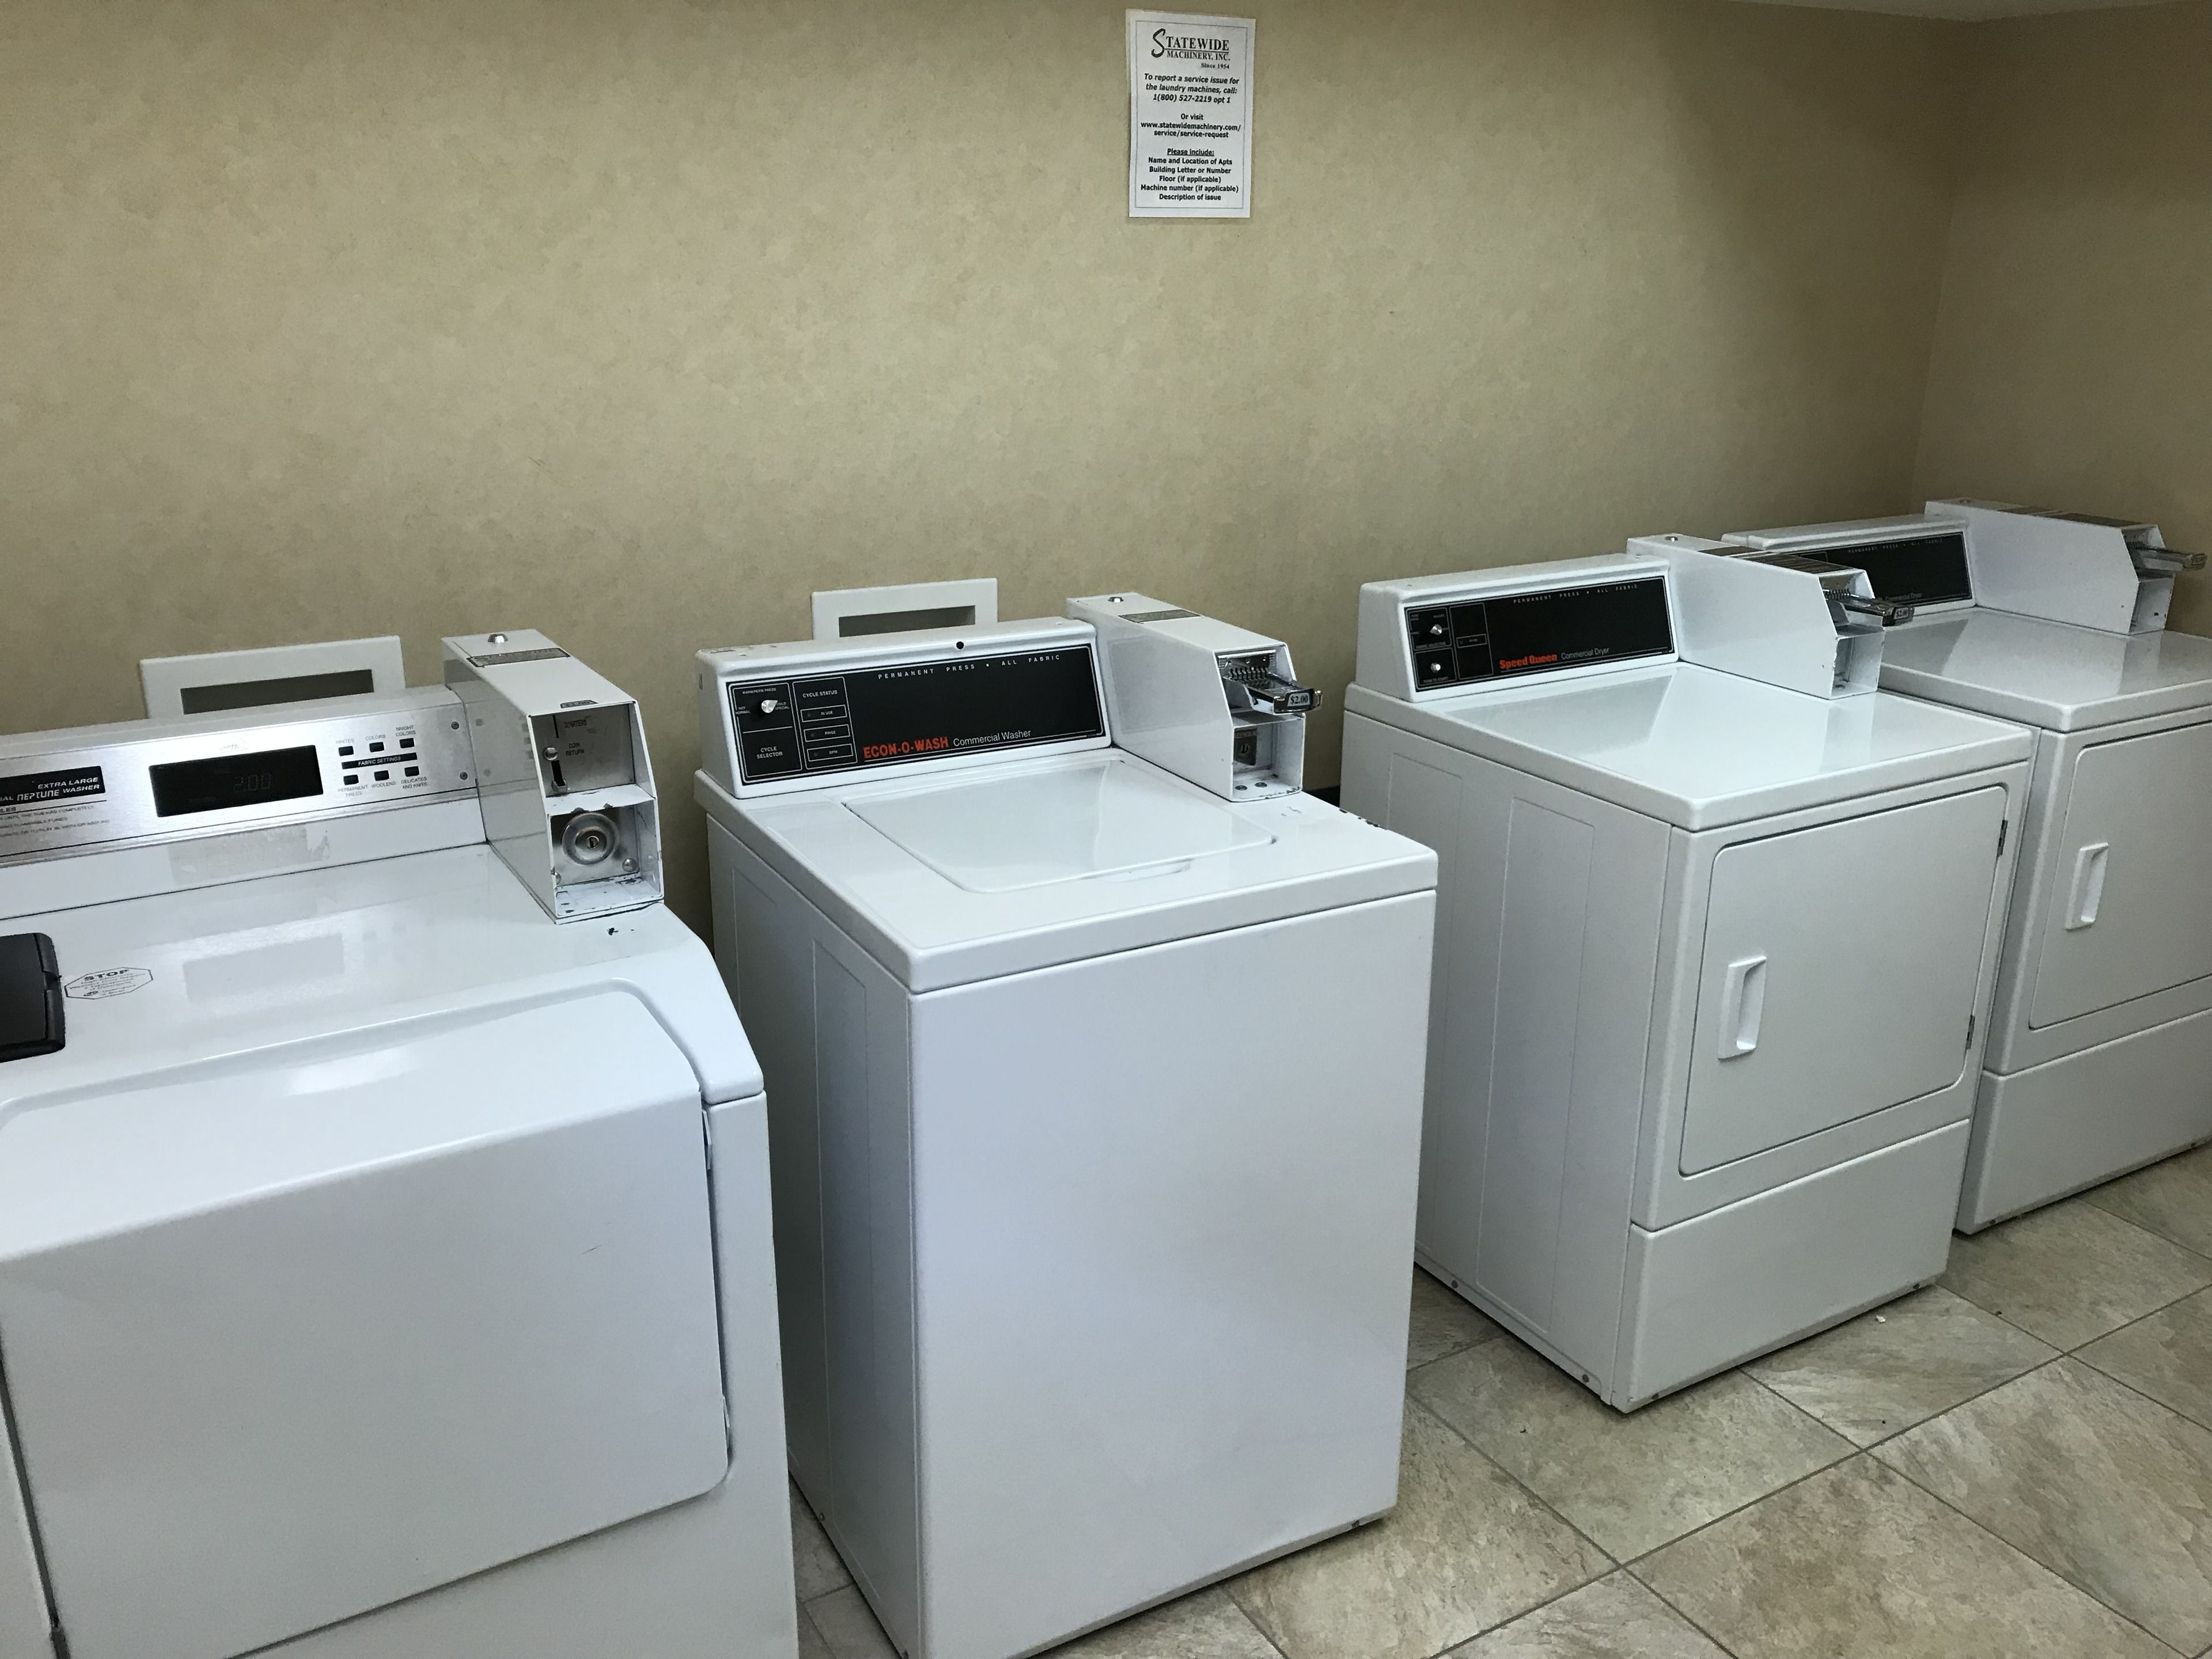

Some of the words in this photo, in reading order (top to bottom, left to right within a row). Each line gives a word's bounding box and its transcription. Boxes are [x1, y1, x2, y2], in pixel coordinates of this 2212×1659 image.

[1152, 28, 1230, 58] STATEWIDE
[1166, 50, 1213, 60] MACHINERY,
[1215, 52, 1230, 61] INC.
[1154, 74, 1176, 83] report
[1228, 77, 1240, 85] for
[1159, 84, 1185, 93] laundry
[1187, 85, 1222, 94] machines,
[1153, 94, 1177, 102] 1(800)
[1179, 94, 1212, 103] 527-2219
[1141, 122, 1241, 132] www.statewidemachinery.com/
[1154, 130, 1229, 139] service/service-request
[1149, 166, 1175, 174] Building
[1187, 176, 1221, 184] applicable)
[1205, 185, 1239, 193] applicable)
[1513, 594, 1552, 604] PERMANENT
[1499, 657, 1528, 669] Speed
[1529, 654, 1557, 665] Queen
[1560, 649, 1593, 660] Commercial
[1594, 647, 1609, 656] Dryer
[878, 668, 934, 680] PERMANENT
[946, 664, 975, 672] PRESS
[1028, 654, 1060, 662] FABRIC
[1290, 694, 1308, 705] $2.00
[953, 733, 1000, 747] Commercial
[1001, 729, 1032, 740] Washer
[377, 756, 402, 764] SETTINGS
[756, 751, 783, 759] SELECTOR
[37, 781, 67, 790] EXTRA
[69, 777, 99, 786] LARGE
[370, 781, 397, 789] WOOLENS
[400, 776, 427, 785] DELICATES
[17, 789, 59, 801] NEPTUNE
[63, 784, 100, 793] WASHER
[84, 969, 130, 980] STOP
